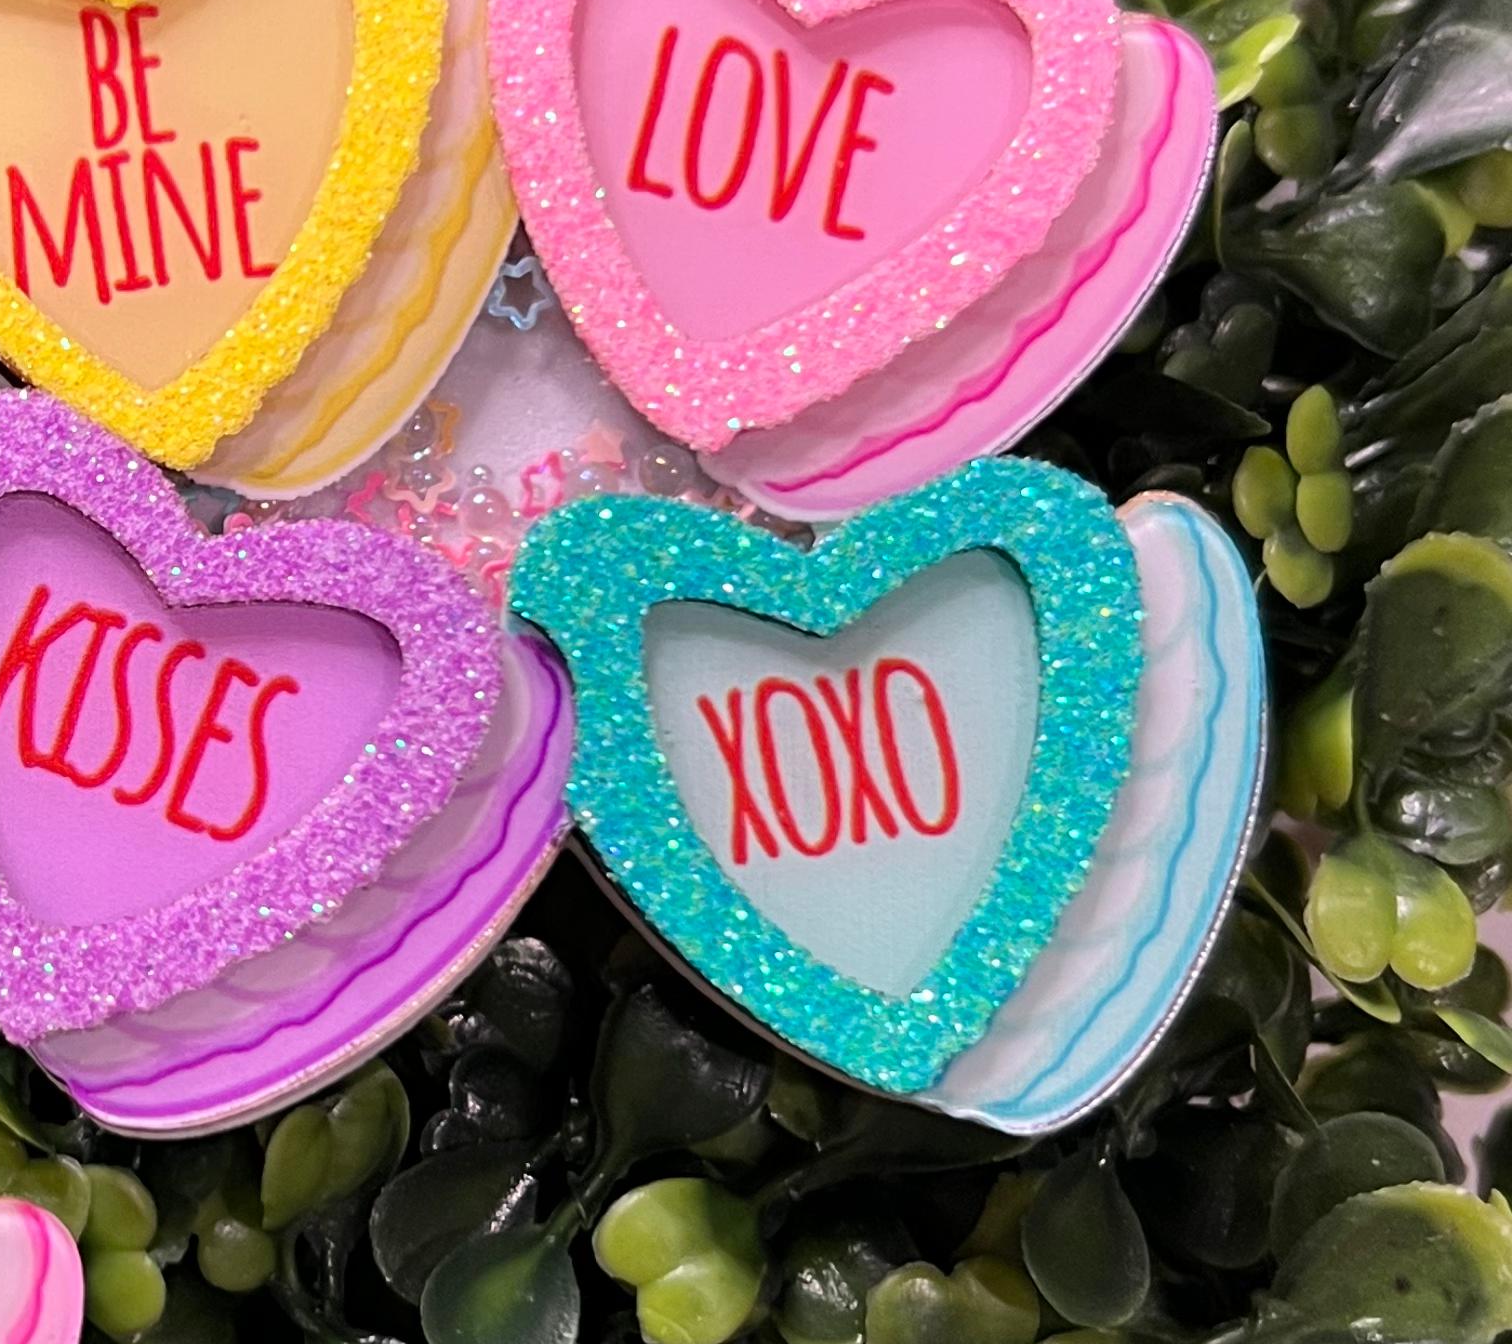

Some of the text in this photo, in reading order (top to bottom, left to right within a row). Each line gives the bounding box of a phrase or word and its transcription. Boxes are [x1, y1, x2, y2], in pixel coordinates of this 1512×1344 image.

[79, 3, 177, 149] BE
[626, 24, 895, 242] LOVE
[6, 136, 278, 305] MINE
[699, 660, 959, 863] XOXO
